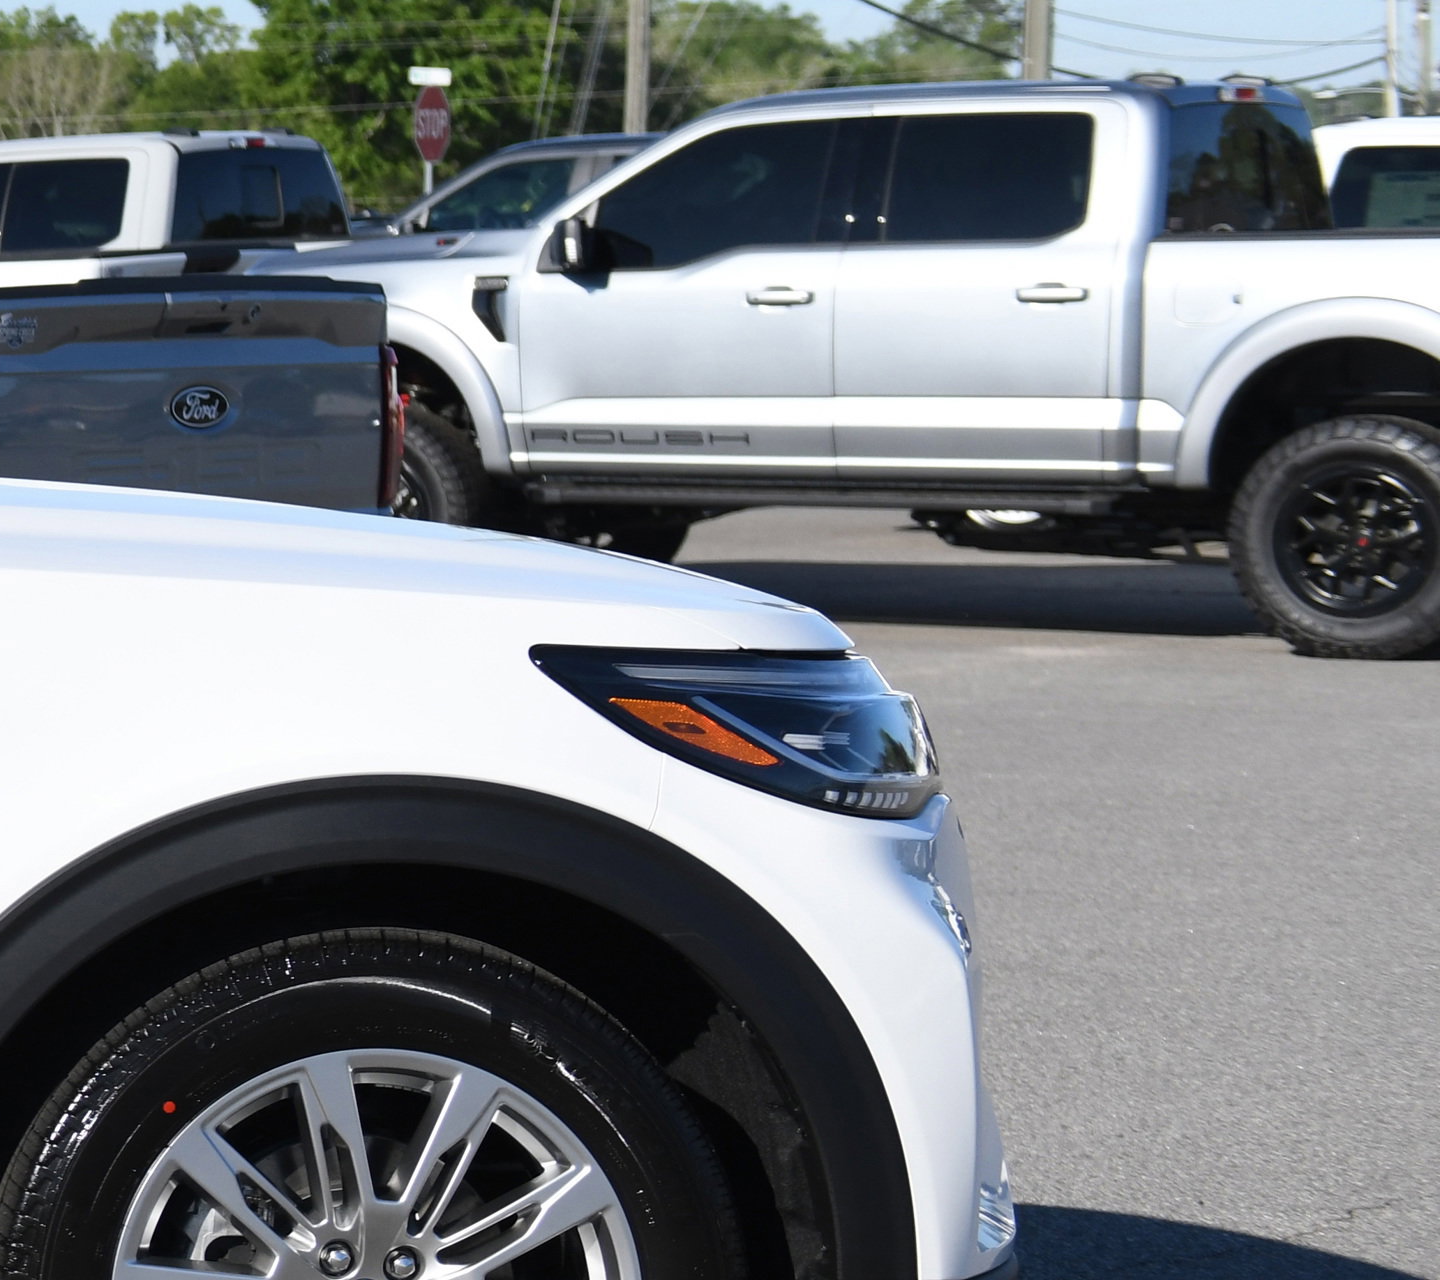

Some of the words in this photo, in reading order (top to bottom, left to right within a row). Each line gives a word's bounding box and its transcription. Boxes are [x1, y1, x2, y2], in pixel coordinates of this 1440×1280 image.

[417, 108, 448, 139] STOP
[182, 391, 220, 420] Ford
[531, 428, 750, 446] ROUSH
